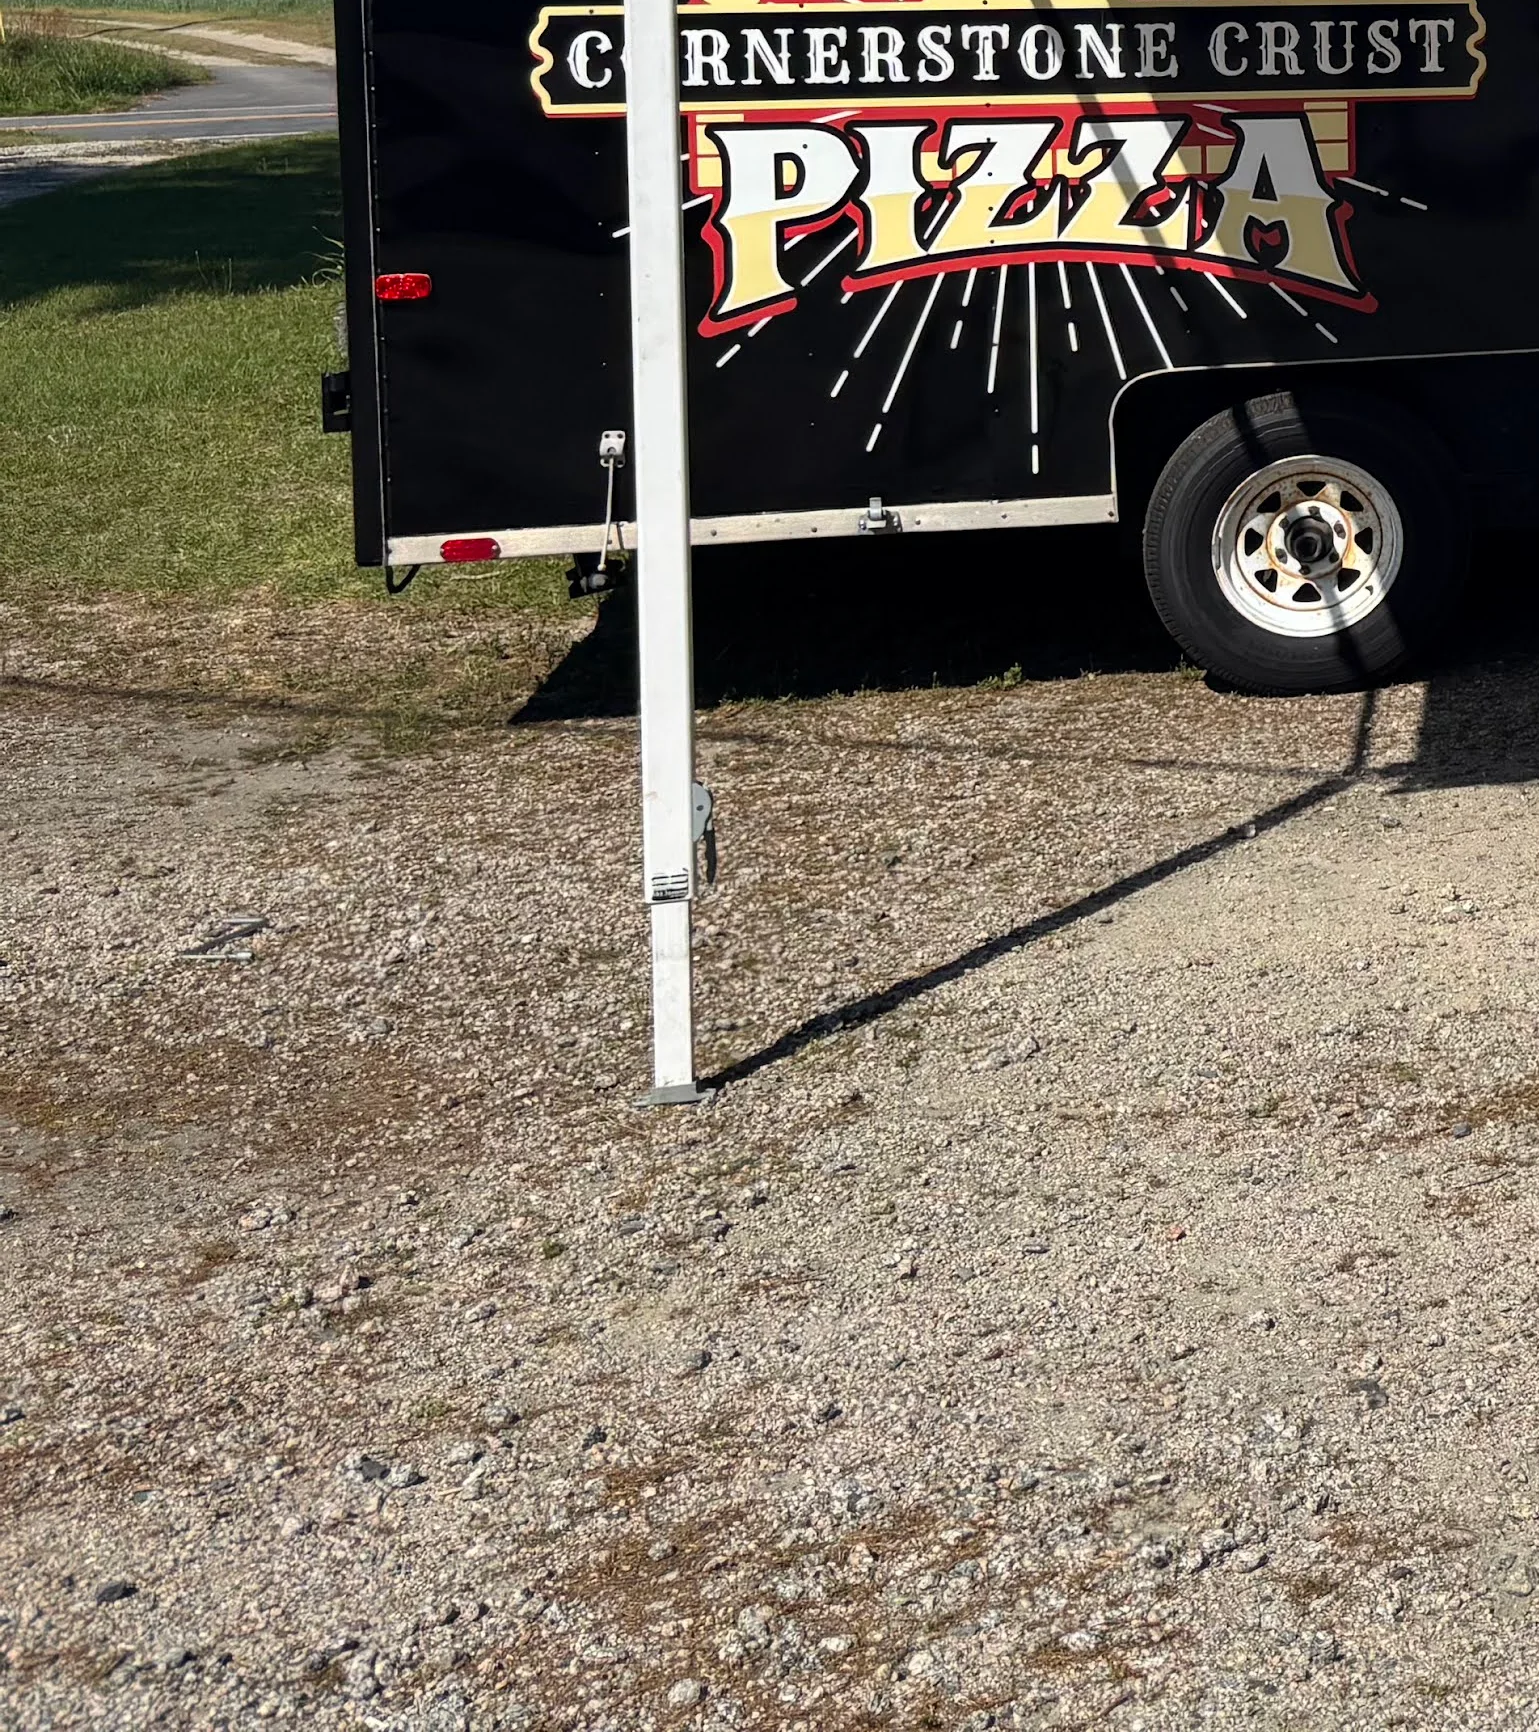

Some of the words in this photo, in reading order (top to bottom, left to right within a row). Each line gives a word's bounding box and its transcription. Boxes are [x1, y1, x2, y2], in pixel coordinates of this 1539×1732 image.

[567, 21, 1178, 88] CRNERSTONE
[1207, 18, 1455, 77] CRUST
[703, 112, 1372, 321] PIZZA
